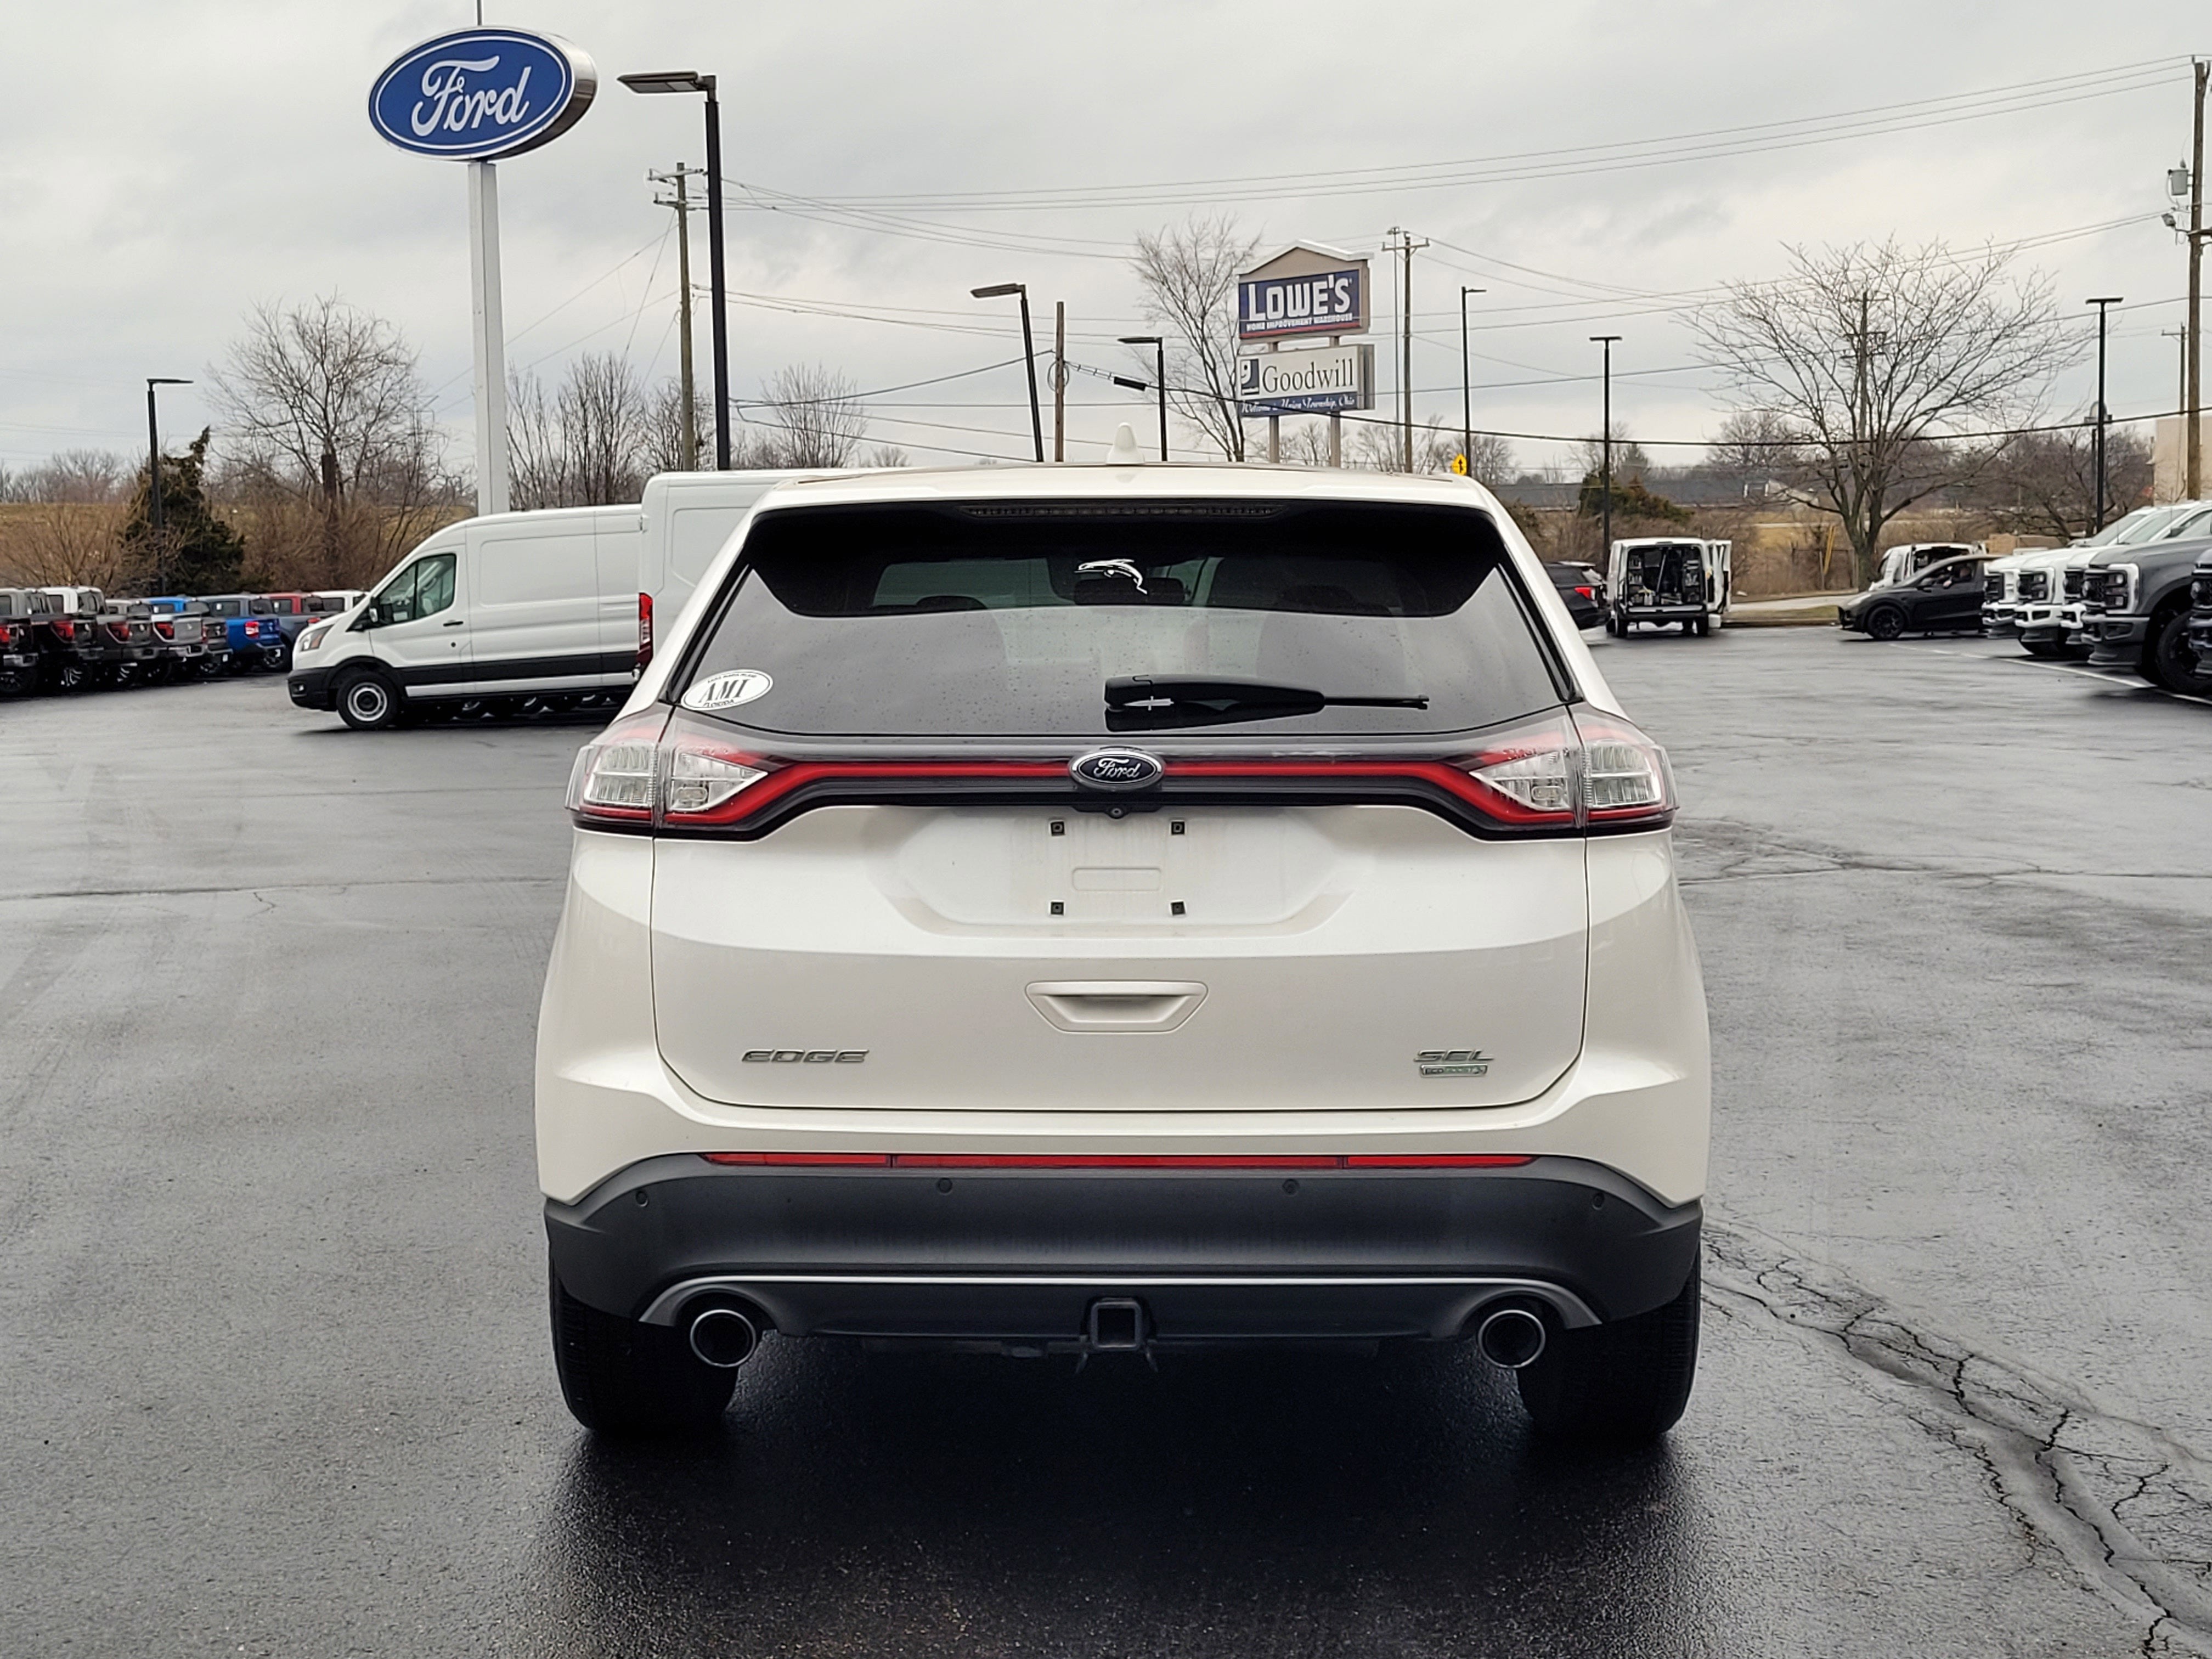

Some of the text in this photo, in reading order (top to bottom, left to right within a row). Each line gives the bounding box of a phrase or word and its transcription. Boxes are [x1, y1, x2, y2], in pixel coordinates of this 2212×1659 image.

[411, 55, 532, 136] Ford
[1248, 274, 1351, 321] LOWE'S
[1262, 358, 1353, 393] Goodwill
[698, 679, 751, 703] AMI
[1093, 758, 1141, 778] Ford
[742, 1048, 870, 1063] EDGE
[1413, 1049, 1494, 1062] SEL
